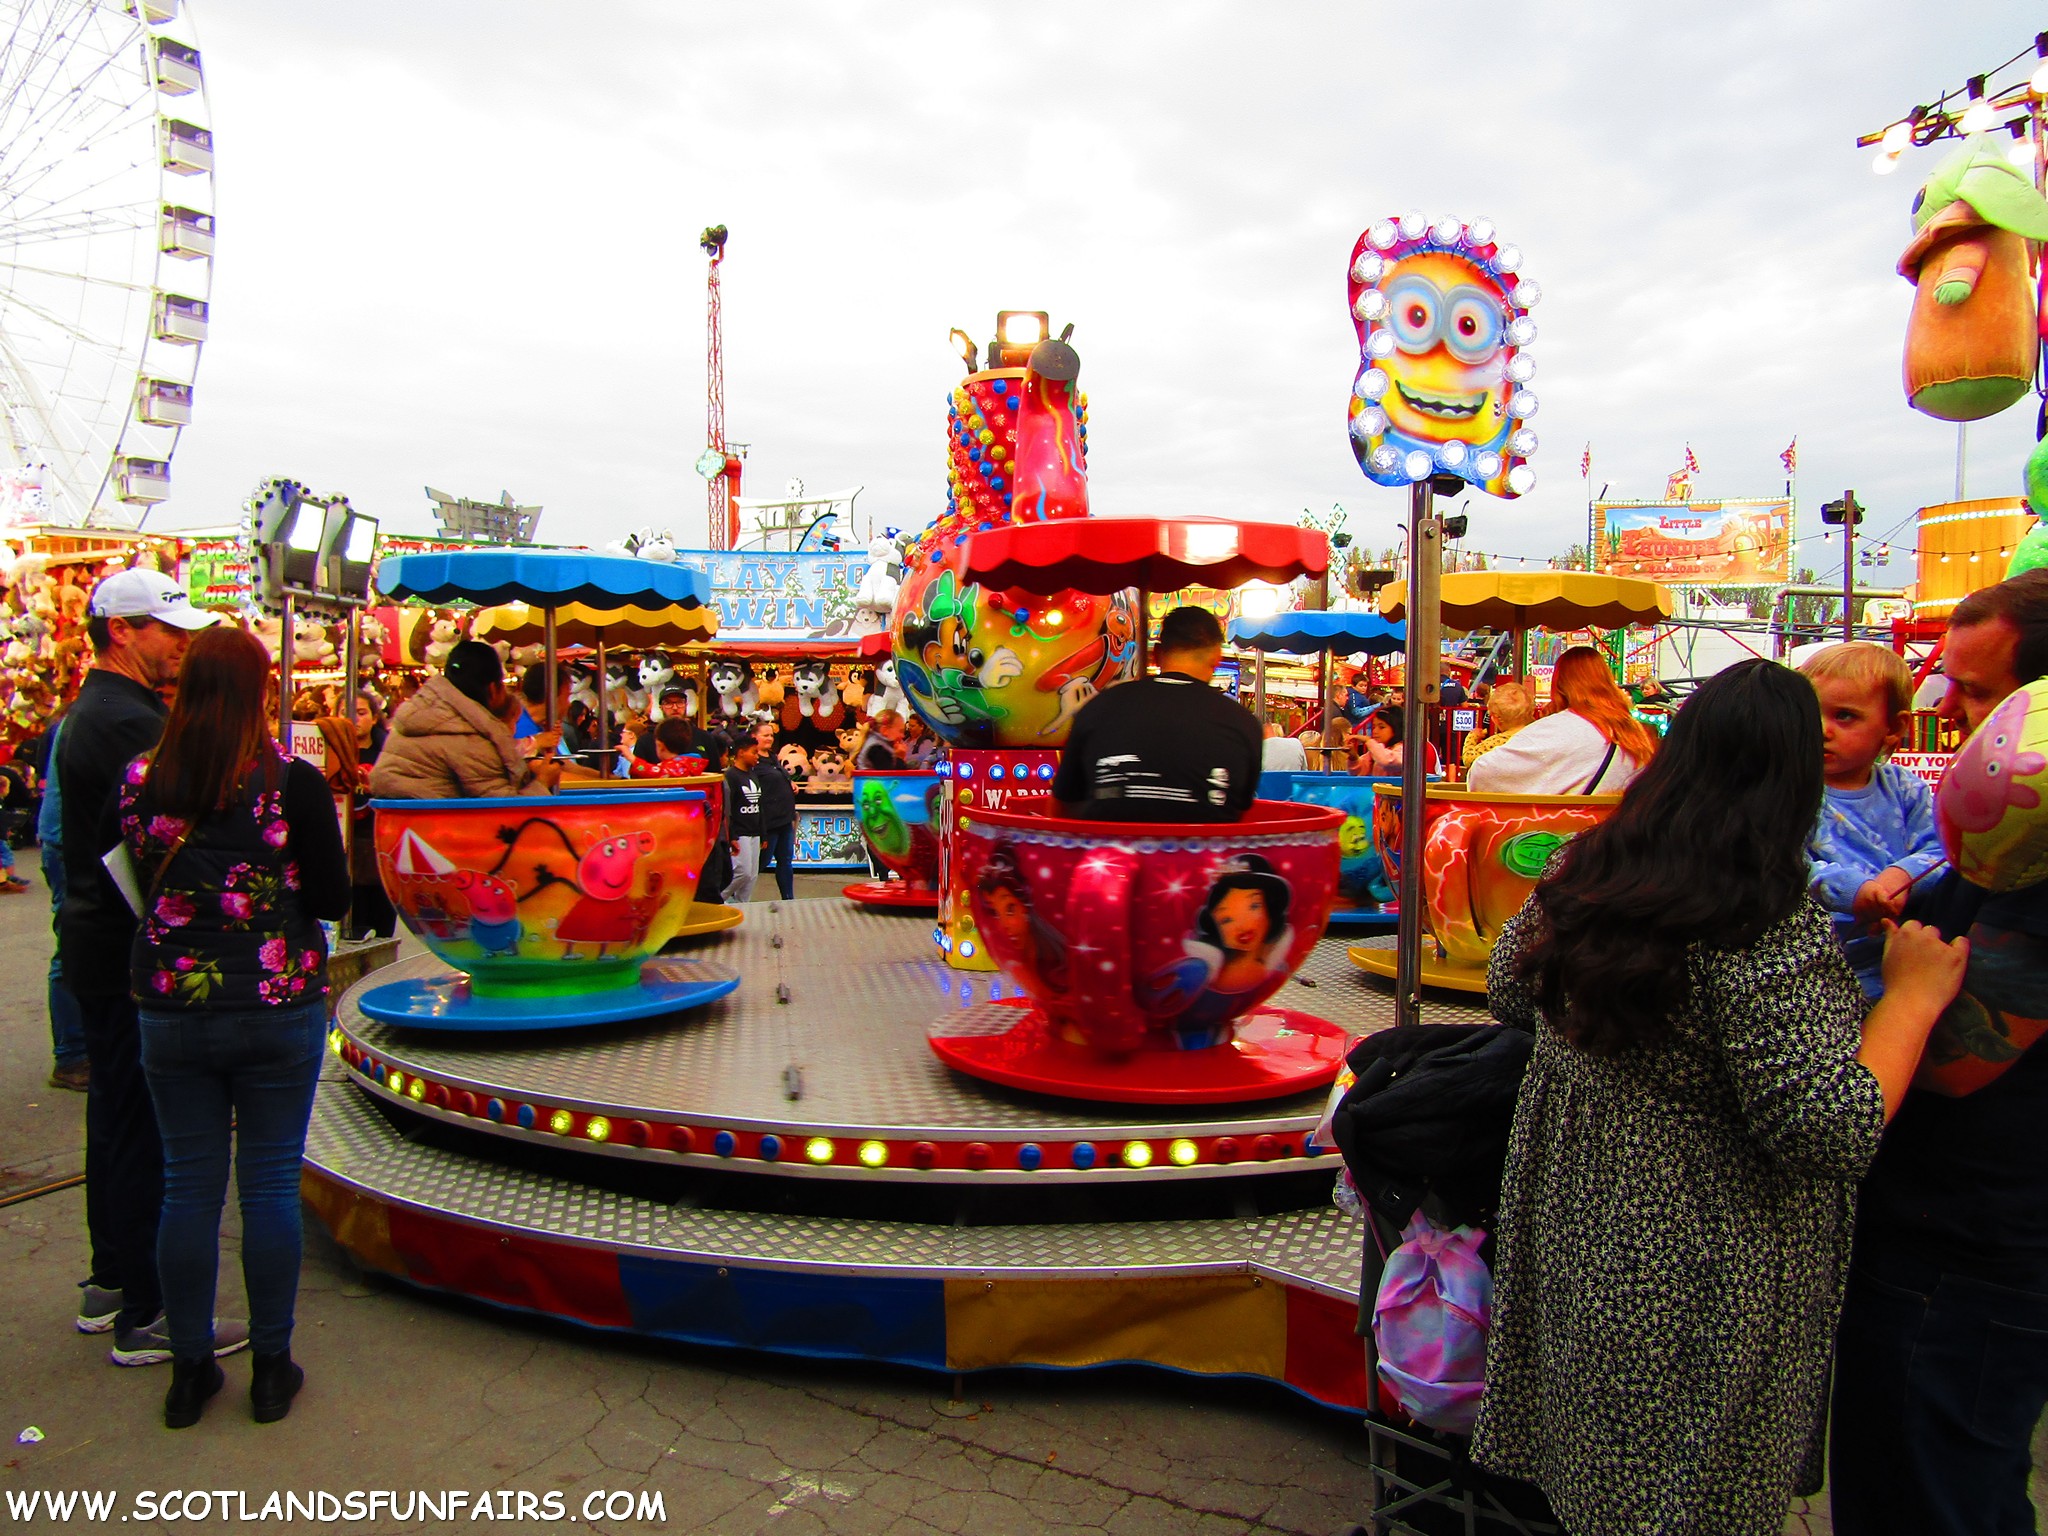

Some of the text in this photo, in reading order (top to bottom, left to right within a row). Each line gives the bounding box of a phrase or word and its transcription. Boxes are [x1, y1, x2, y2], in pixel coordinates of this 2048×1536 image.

[1659, 516, 1702, 528] LITTLE
[699, 562, 796, 590] LAY
[1148, 588, 1230, 618] GAMES
[716, 597, 827, 628] WIN
[1456, 716, 1472, 725] £3.00
[294, 736, 323, 754] FARE
[1891, 757, 1922, 767] BUY
[812, 817, 850, 835] TO
